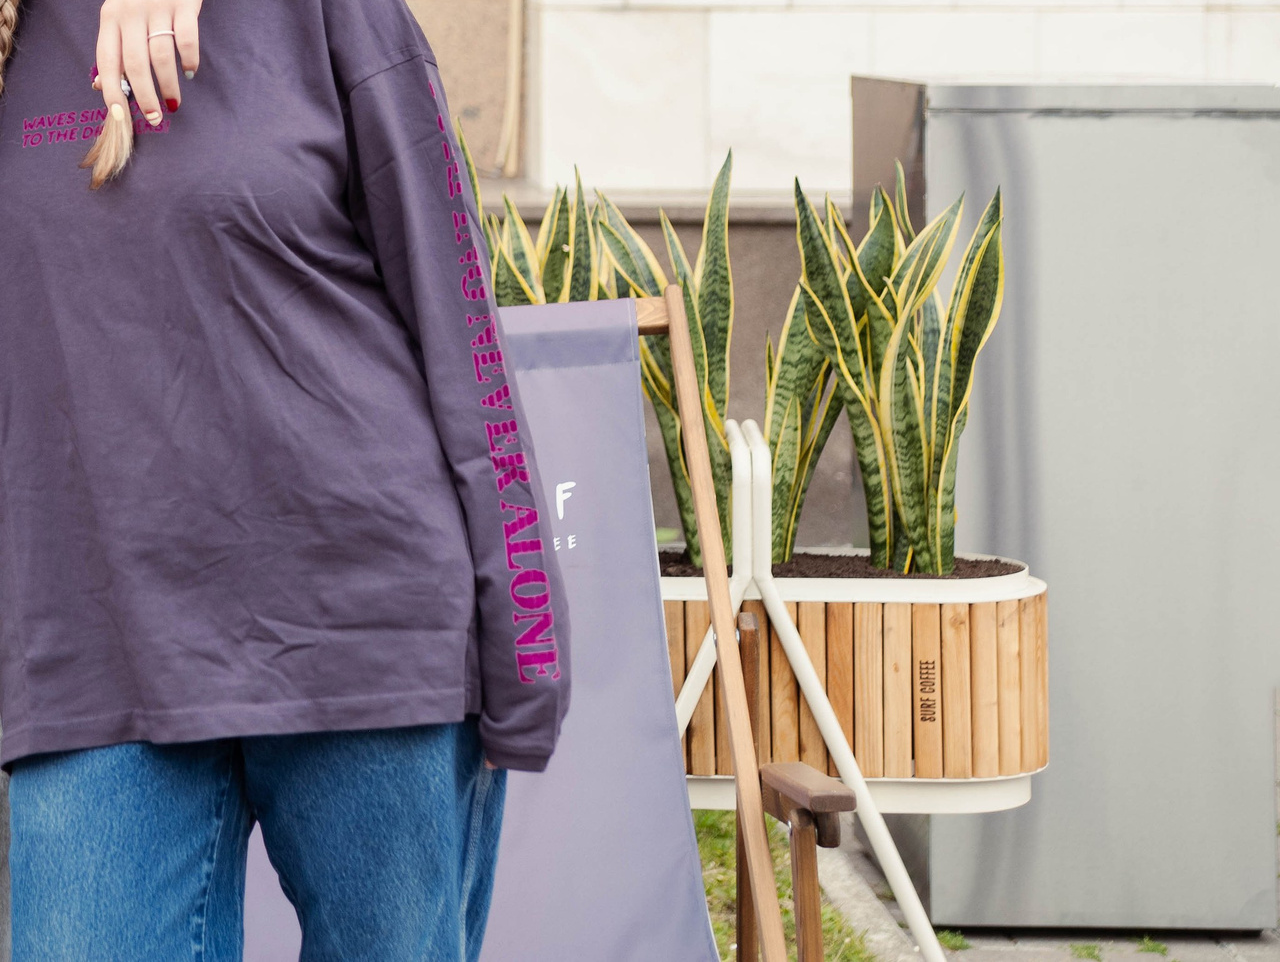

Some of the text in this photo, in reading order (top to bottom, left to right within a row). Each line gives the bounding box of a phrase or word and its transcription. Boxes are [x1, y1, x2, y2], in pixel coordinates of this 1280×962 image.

[22, 132, 43, 149] TO
[46, 126, 78, 144] THE
[23, 111, 77, 132] WAVES
[79, 107, 108, 125] SIN
[500, 499, 562, 685] ALONE
[919, 660, 937, 722] SURF COFFEE
